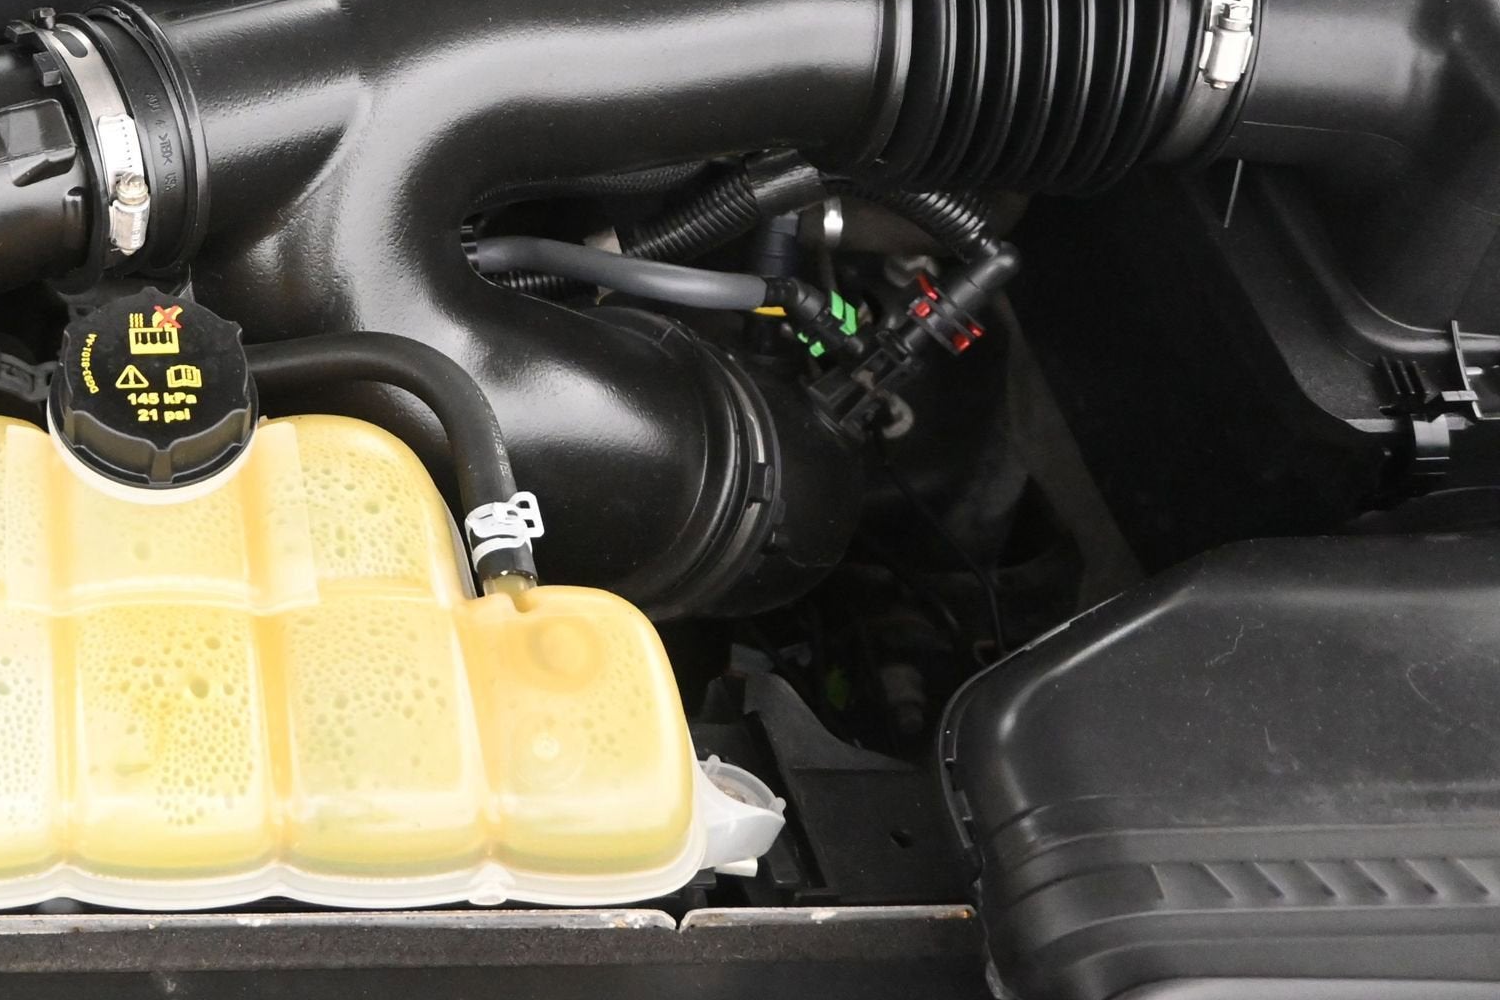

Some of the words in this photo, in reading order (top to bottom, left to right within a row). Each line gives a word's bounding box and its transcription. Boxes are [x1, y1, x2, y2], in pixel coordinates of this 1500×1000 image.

[127, 392, 160, 406] 145
[163, 391, 198, 404] kPa
[137, 408, 158, 421] 21
[164, 407, 191, 424] psi
